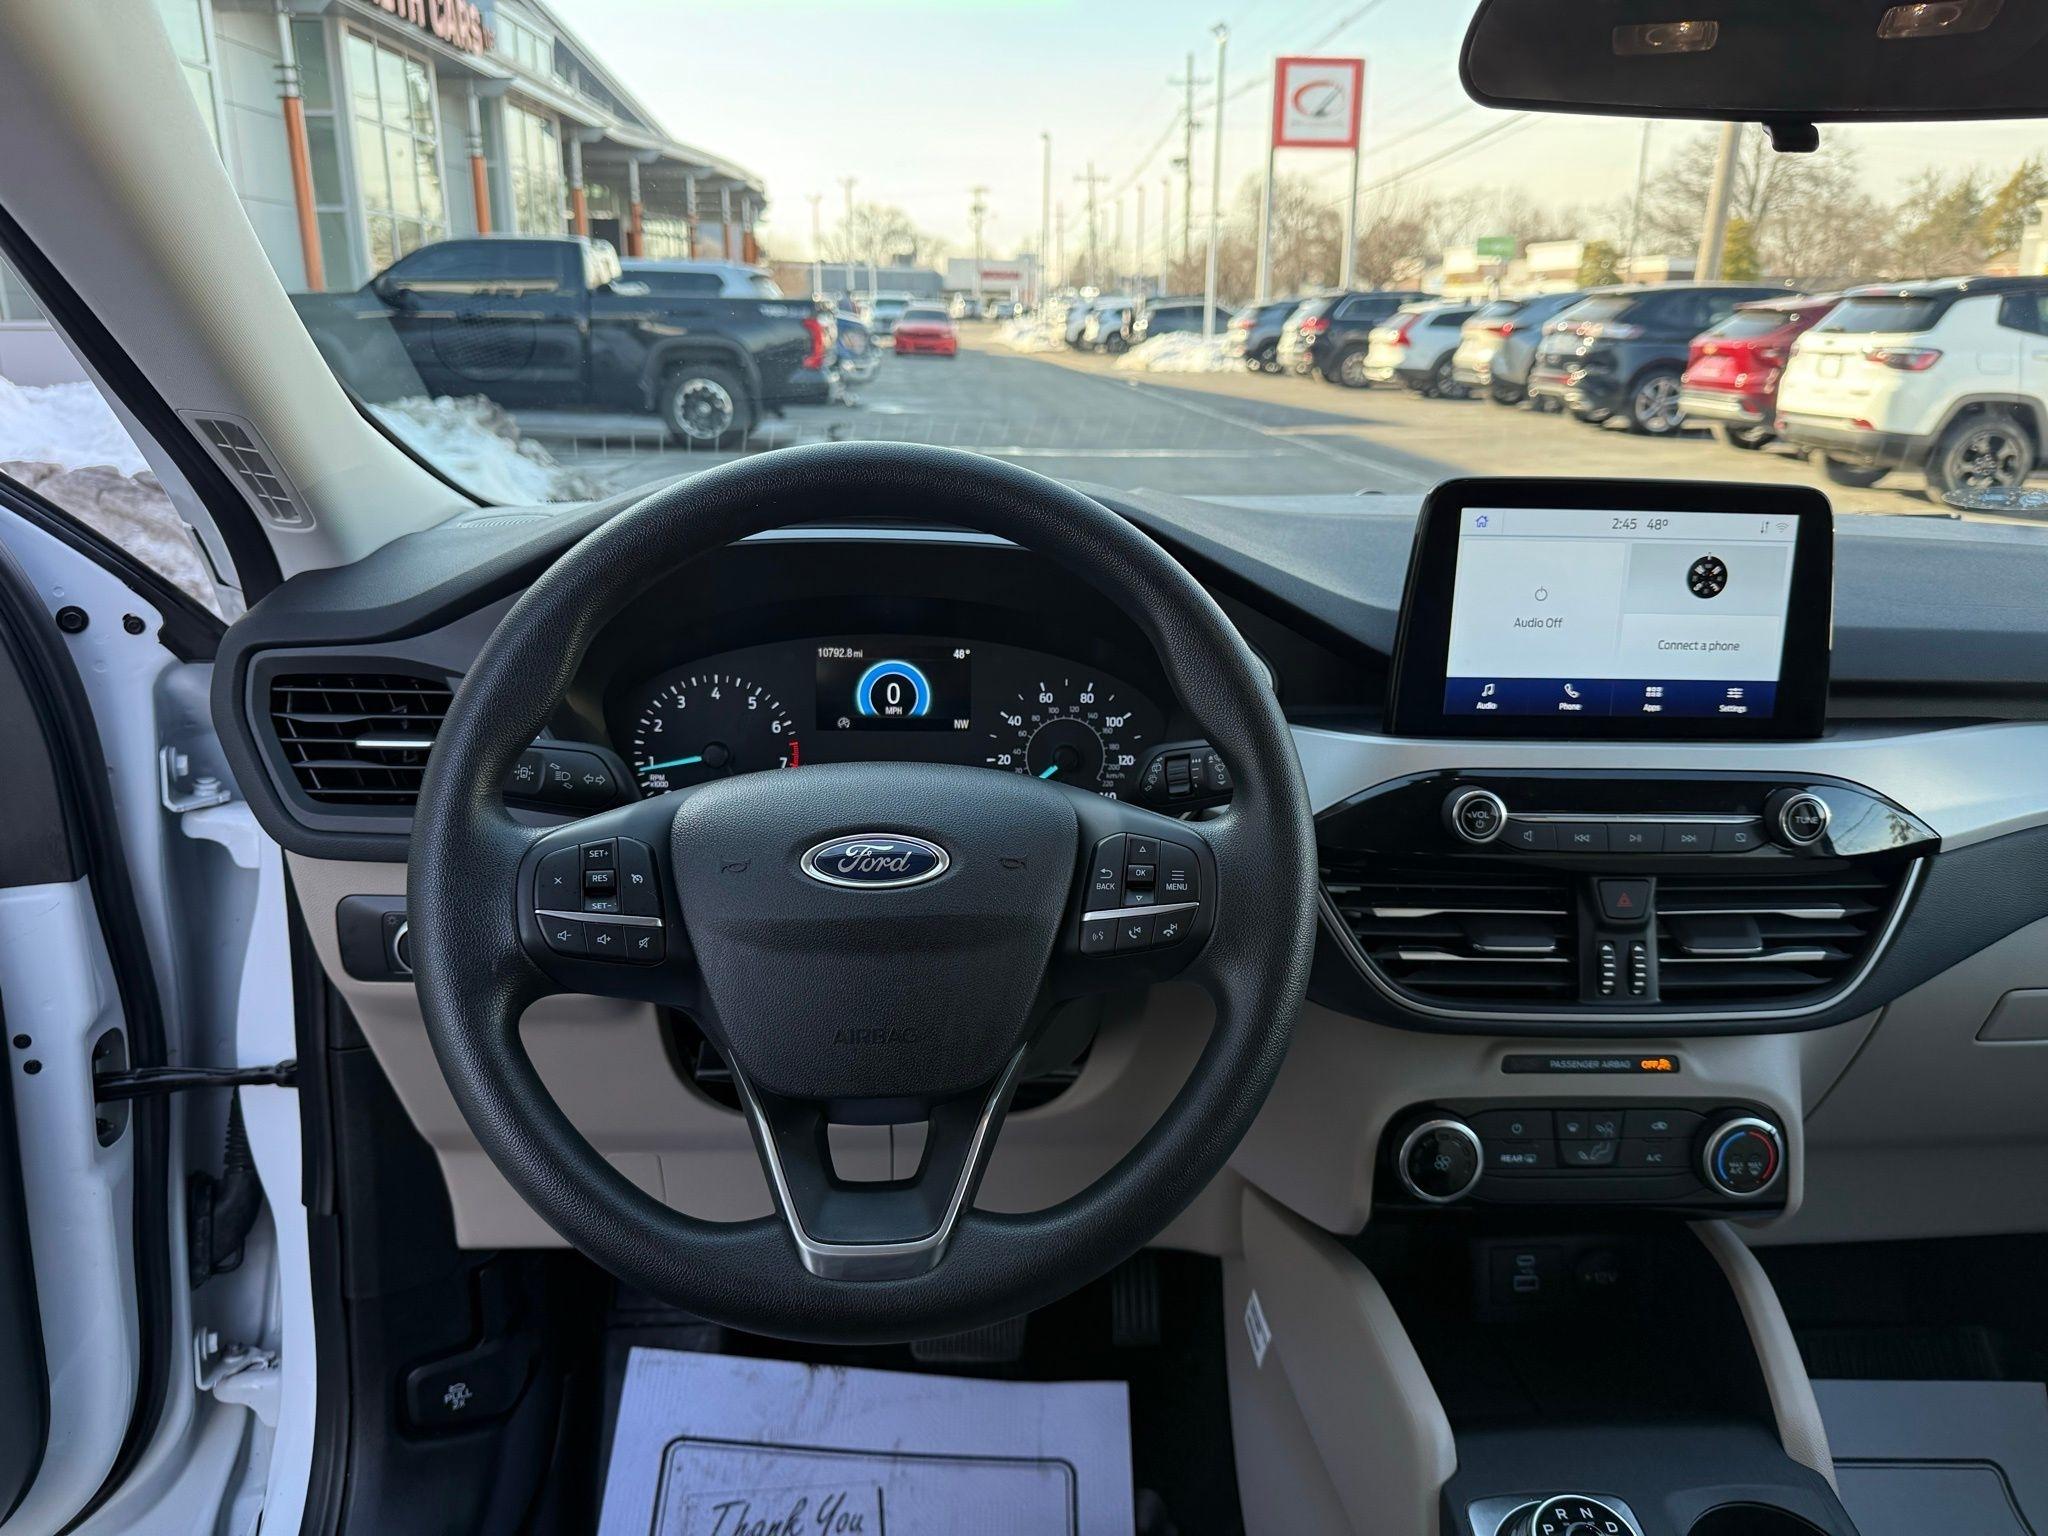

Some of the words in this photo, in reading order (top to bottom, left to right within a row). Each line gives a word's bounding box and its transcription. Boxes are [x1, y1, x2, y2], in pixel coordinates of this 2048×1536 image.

[1612, 518, 1637, 530] 2:45
[1513, 617, 1544, 628] Audio
[1546, 617, 1563, 628] Off
[1657, 639, 1698, 651] Connect
[1700, 642, 1707, 651] a
[1708, 640, 1740, 653] phone
[711, 687, 721, 700] 4
[886, 682, 900, 704] 0
[1039, 692, 1053, 704] 60
[1080, 692, 1094, 704] 80
[677, 695, 686, 709] 3
[748, 696, 757, 710] 5
[1476, 701, 1498, 710] Audio
[1558, 702, 1583, 711] Phone
[885, 706, 903, 715] MPH
[1719, 704, 1748, 714] Settings
[653, 719, 663, 733] 2
[771, 720, 781, 734] 6
[953, 719, 970, 729] NW
[1007, 715, 1022, 727] 40
[1105, 716, 1124, 727] 100
[1018, 730, 1028, 738] 60
[1013, 748, 1022, 756] 40
[779, 757, 788, 769] 7
[997, 754, 1012, 765] 20
[1118, 755, 1134, 766] 120
[1471, 811, 1490, 819] VOL
[589, 849, 609, 858] SET+
[837, 844, 913, 873] Ford
[592, 874, 608, 882] RES
[1135, 869, 1146, 877] OK
[1166, 883, 1188, 891] MENU
[1500, 1154, 1523, 1163] REAR
[712, 1496, 808, 1536] Thank
[816, 1491, 864, 1536] You
[1555, 1508, 1568, 1520] R
[1579, 1507, 1594, 1519] N
[1542, 1523, 1554, 1535] P
[1605, 1521, 1618, 1533] D
